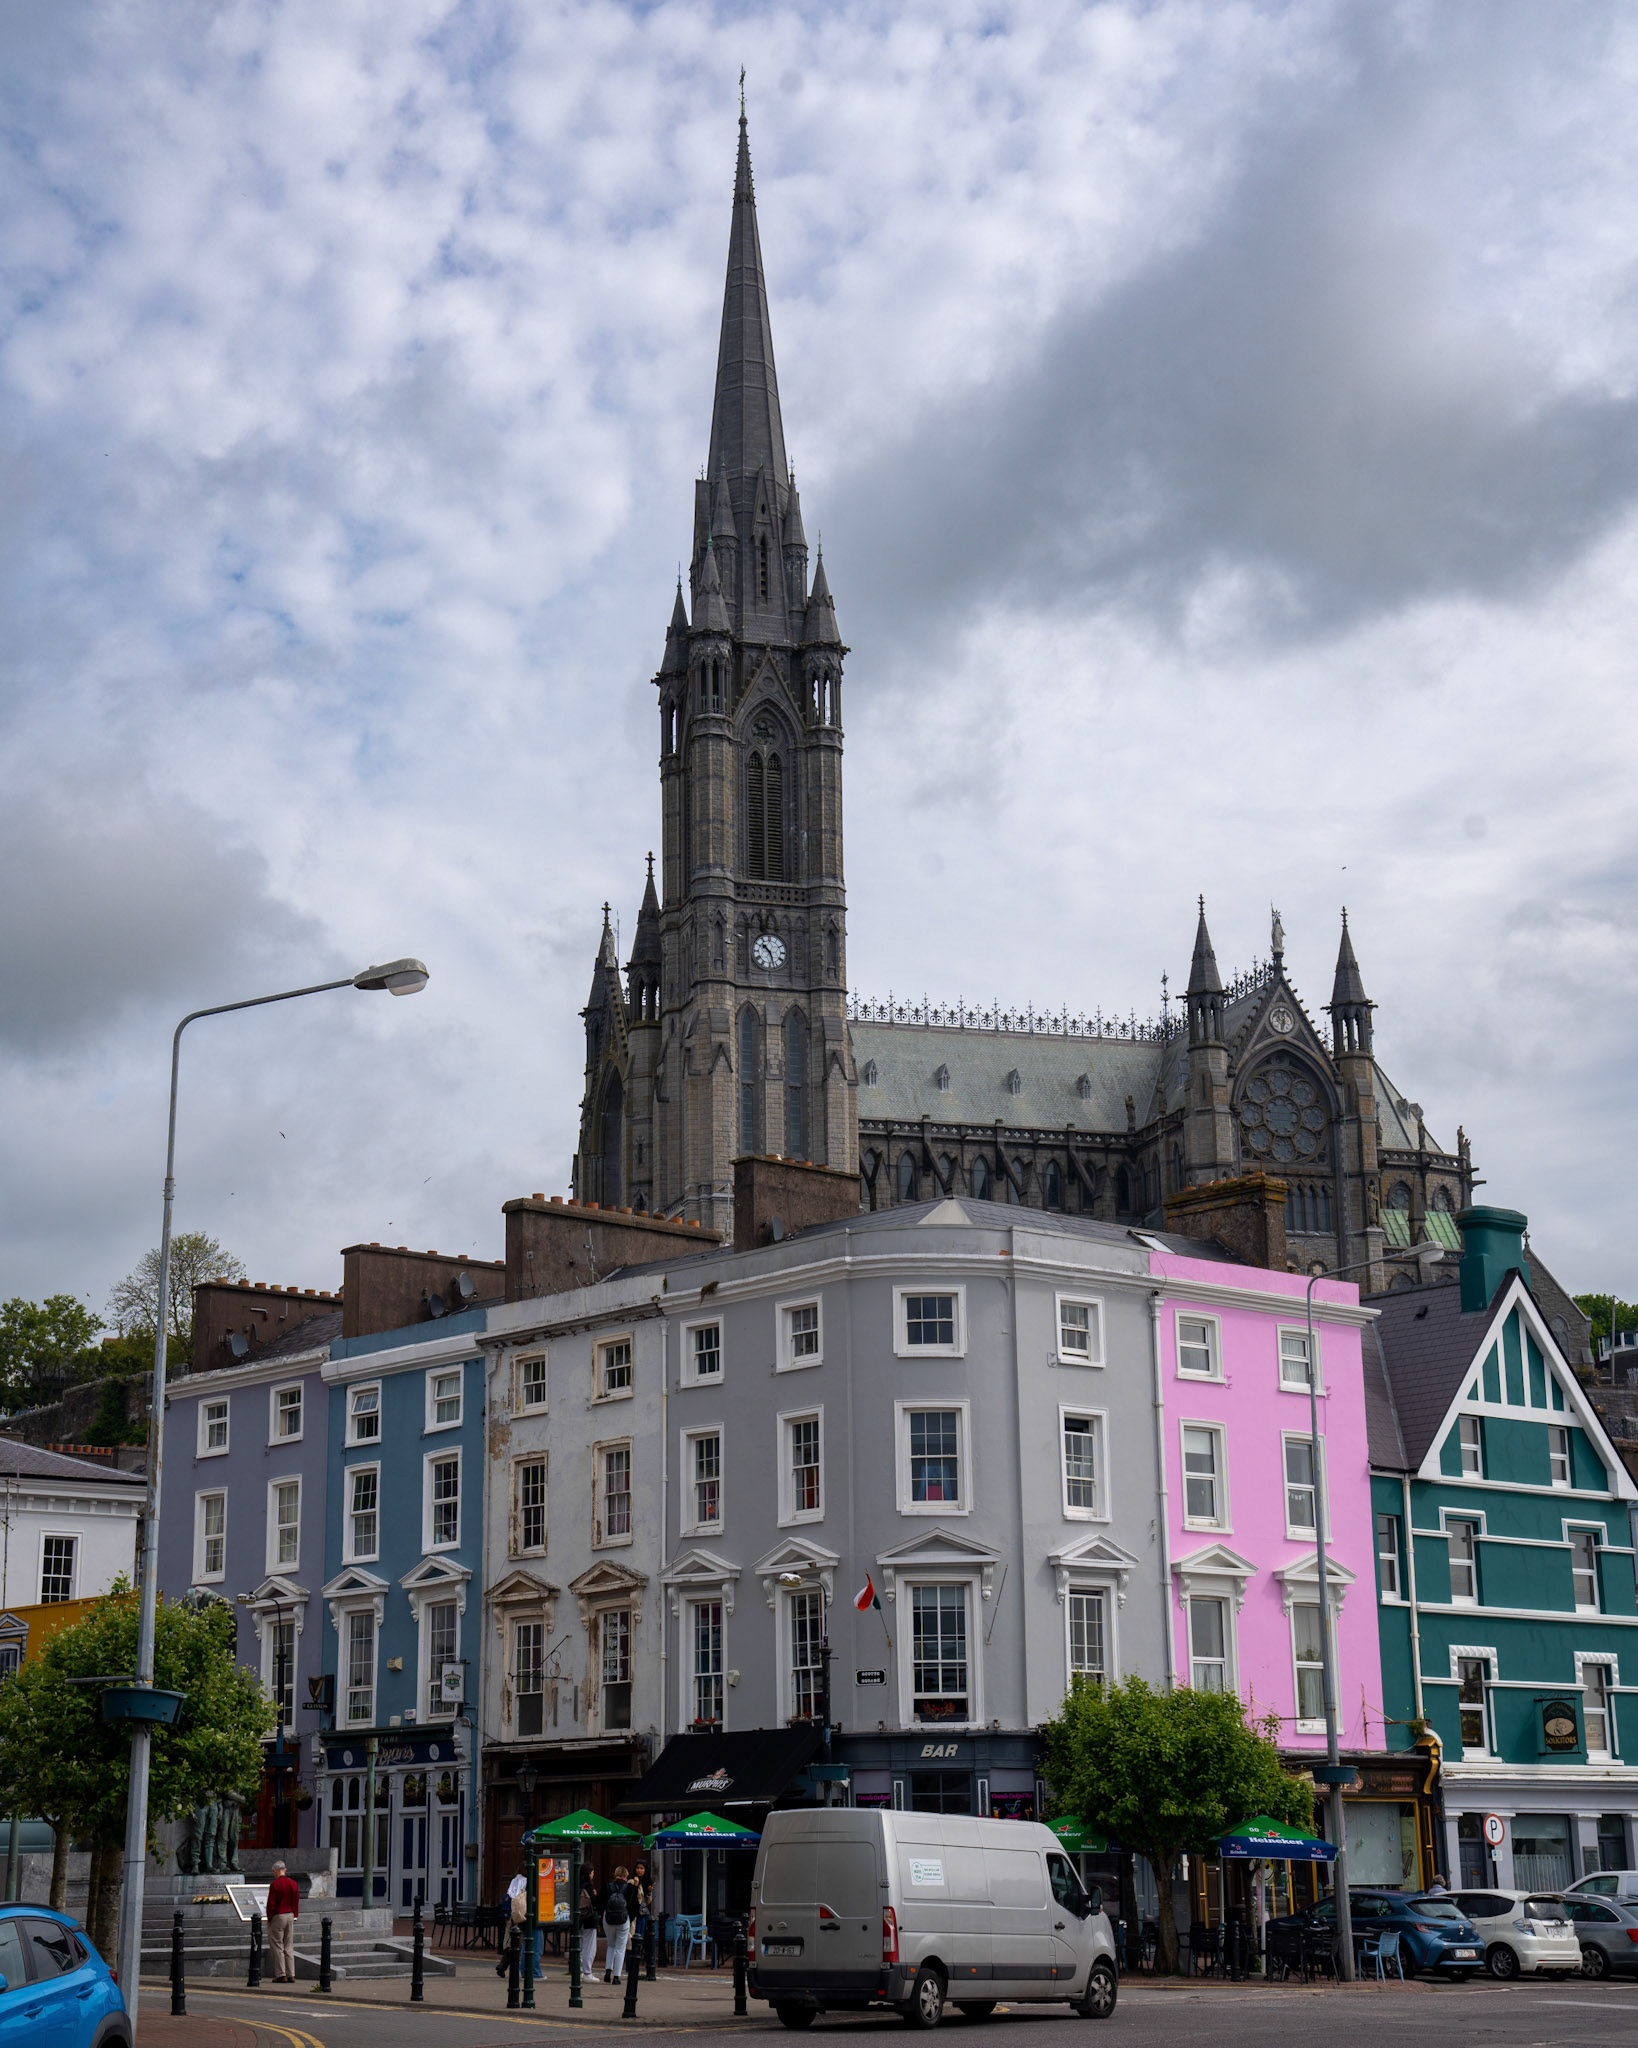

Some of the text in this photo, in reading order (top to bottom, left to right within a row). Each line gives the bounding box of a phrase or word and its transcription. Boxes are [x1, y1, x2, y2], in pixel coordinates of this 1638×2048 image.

[1545, 1736, 1577, 1745] SOLICITORS
[920, 1744, 958, 1758] BAR
[1490, 1819, 1498, 1839] P
[1248, 1837, 1304, 1846] Heineken
